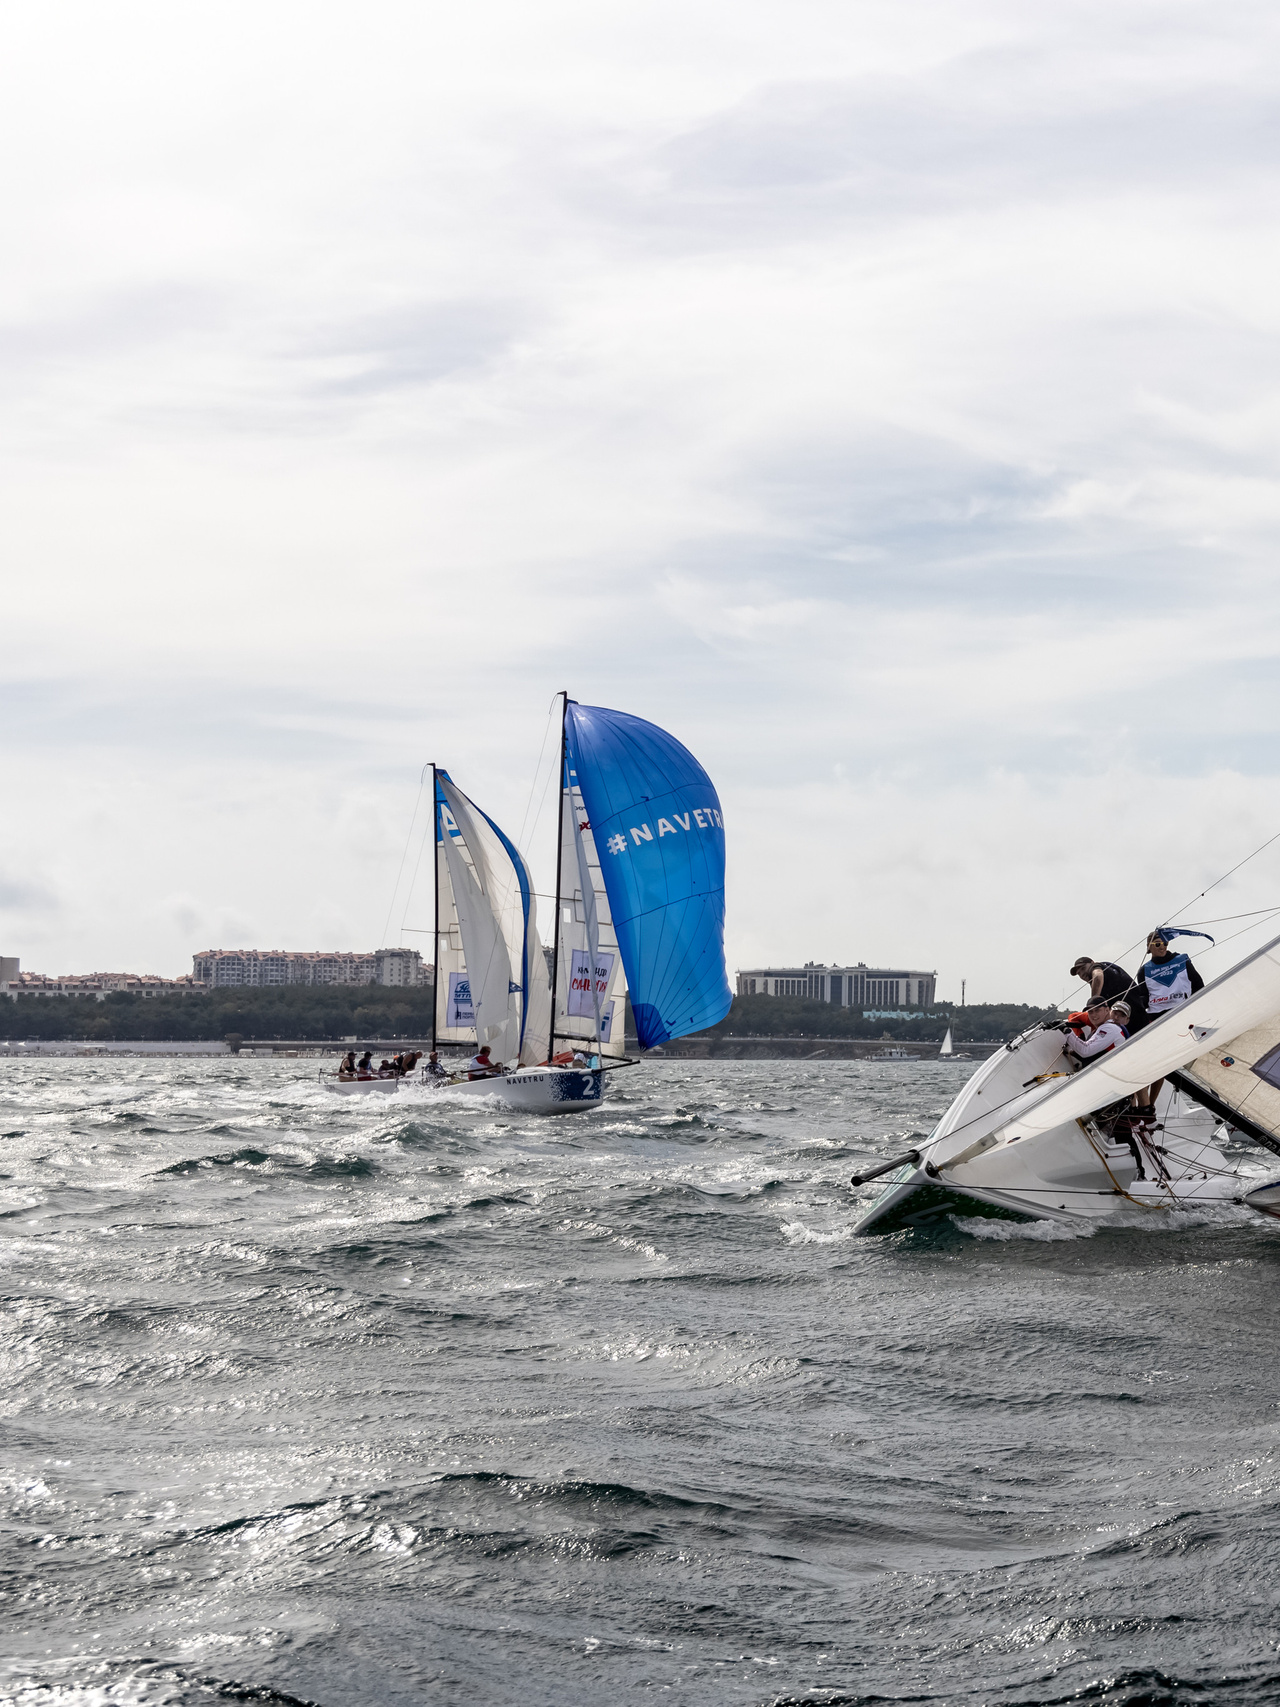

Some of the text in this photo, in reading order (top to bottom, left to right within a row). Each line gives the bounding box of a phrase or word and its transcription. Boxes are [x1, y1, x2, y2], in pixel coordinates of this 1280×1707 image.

[606, 808, 724, 855] #NAVETR
[571, 978, 608, 992] СИНЕГИЯ
[506, 1075, 544, 1085] NAVETRU
[581, 1075, 595, 1096] 2
